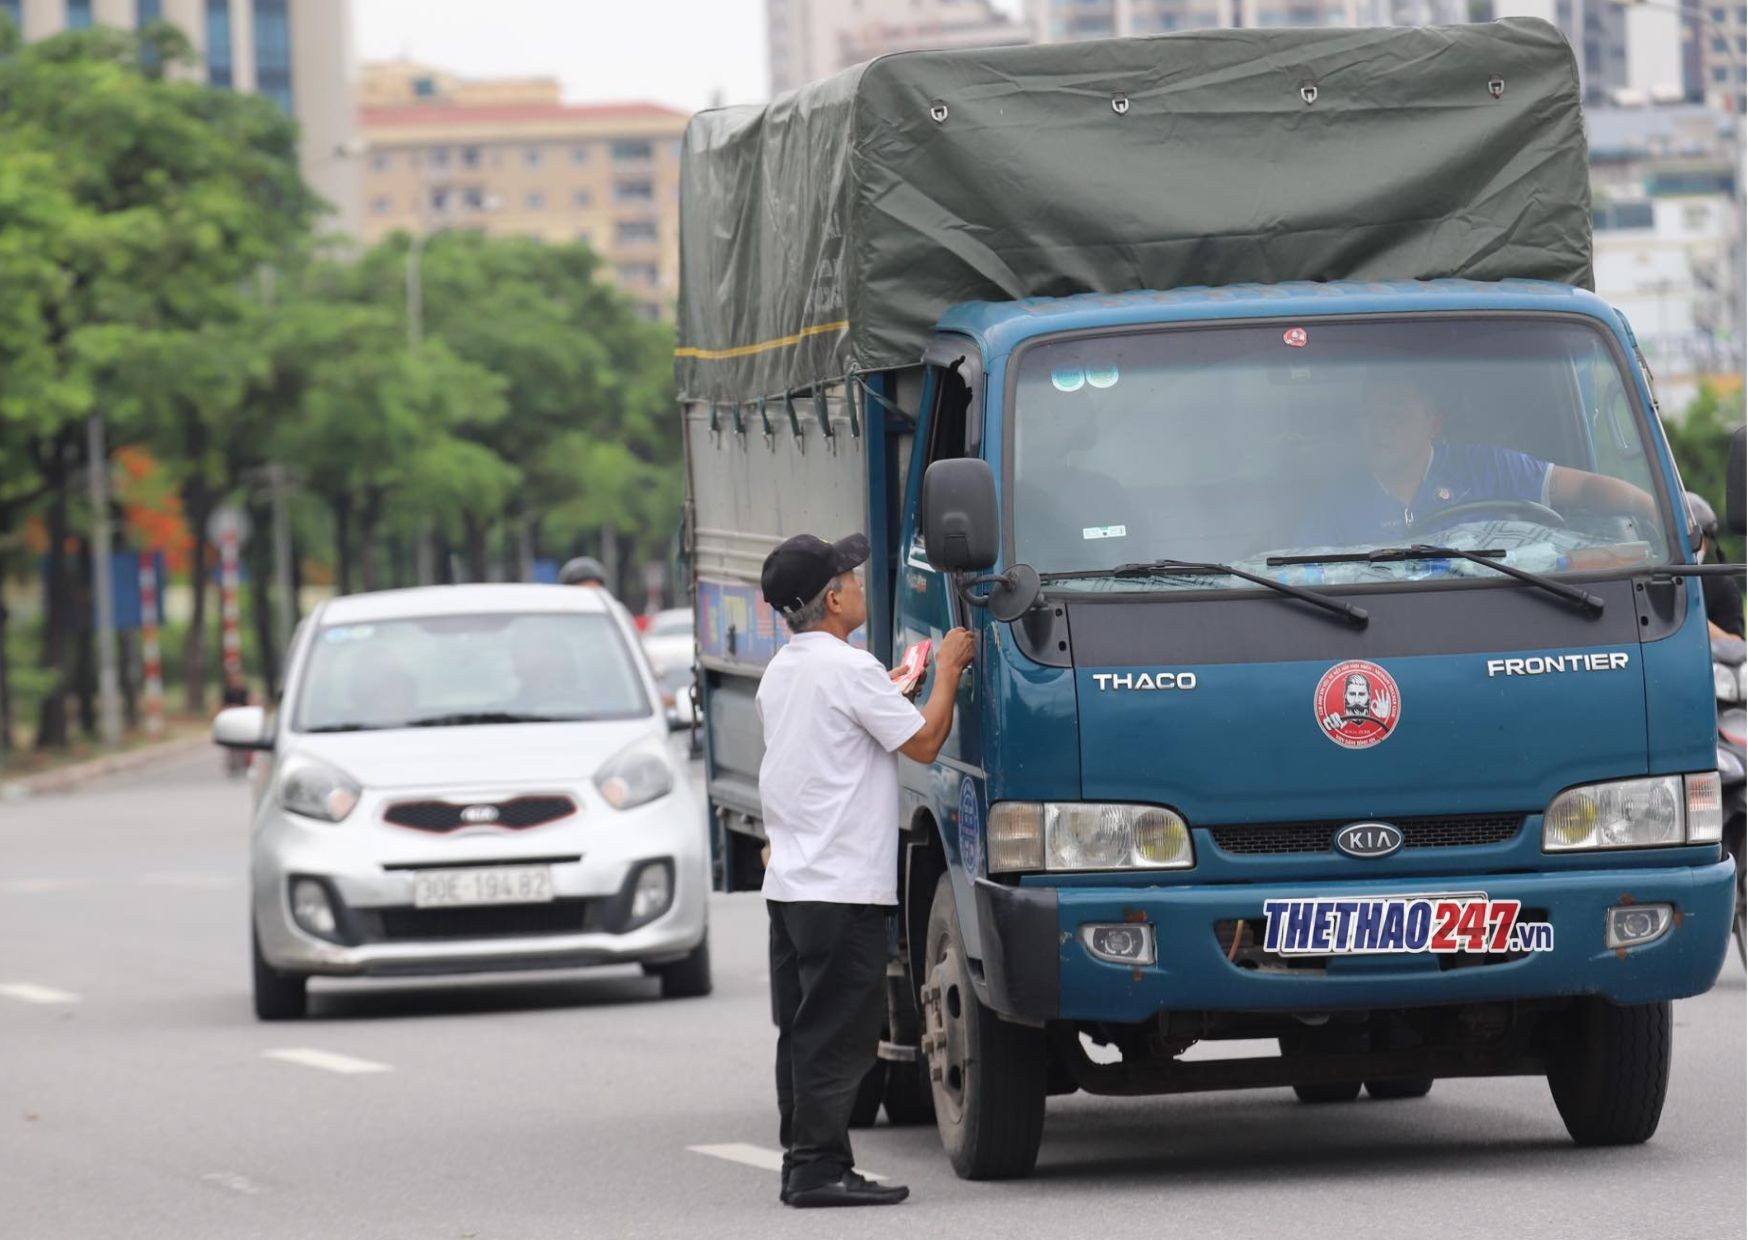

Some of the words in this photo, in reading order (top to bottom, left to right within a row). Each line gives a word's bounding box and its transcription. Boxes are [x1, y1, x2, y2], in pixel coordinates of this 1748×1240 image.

[1487, 652, 1630, 677] FRONTIER
[1093, 672, 1197, 691] THACO
[1349, 831, 1392, 849] KIA
